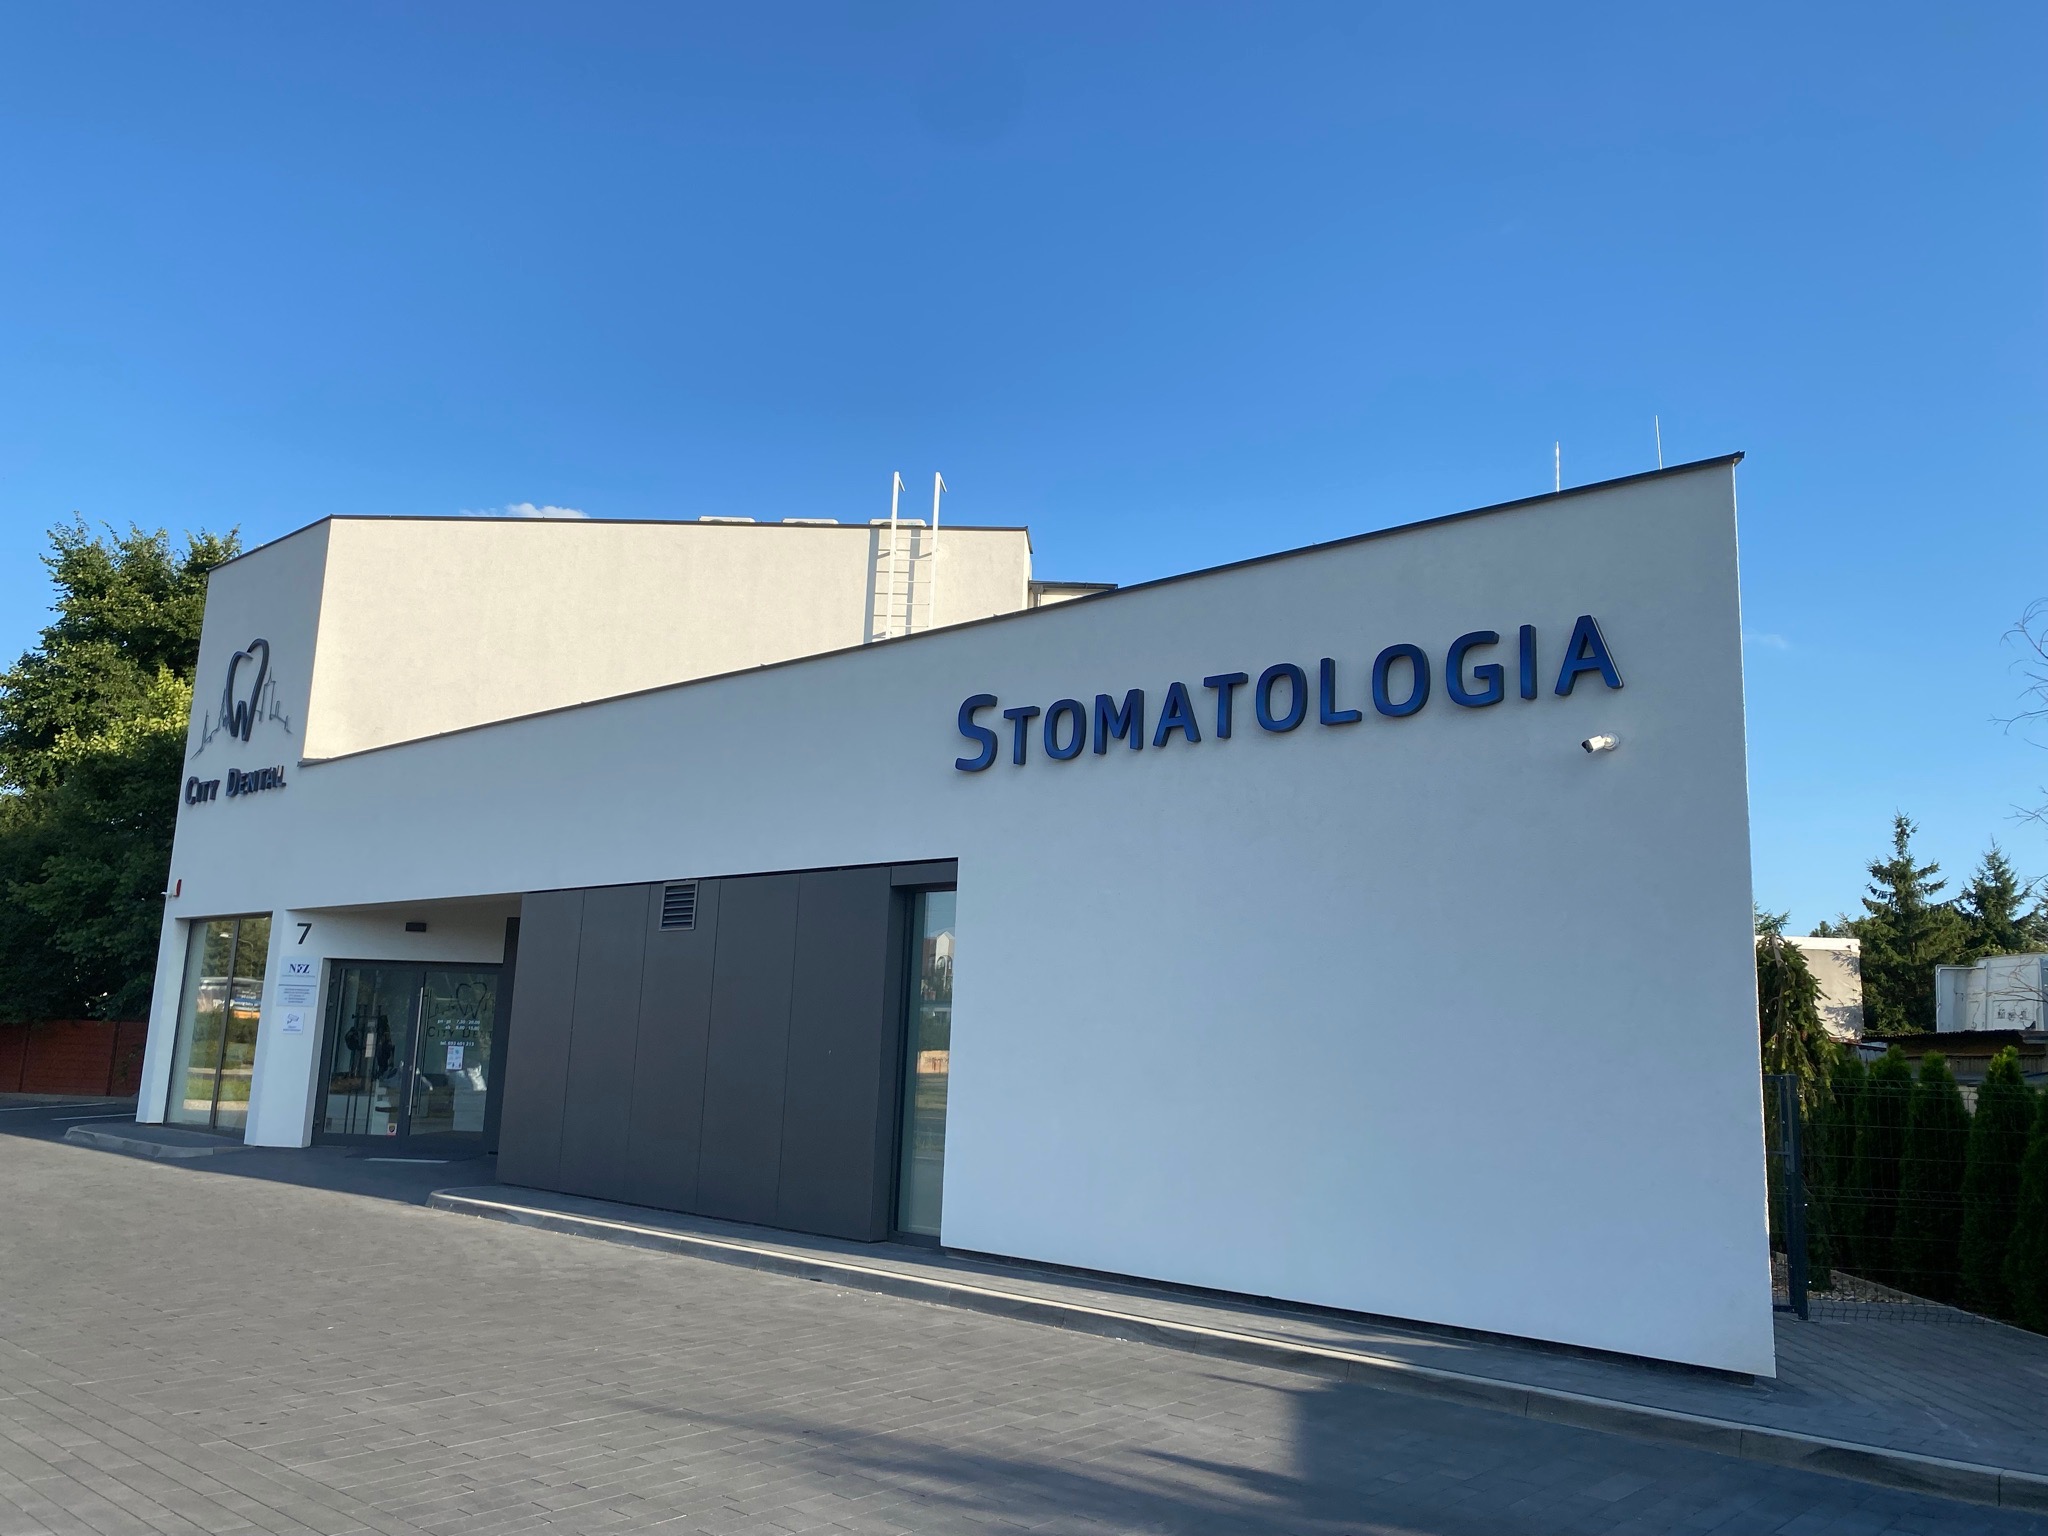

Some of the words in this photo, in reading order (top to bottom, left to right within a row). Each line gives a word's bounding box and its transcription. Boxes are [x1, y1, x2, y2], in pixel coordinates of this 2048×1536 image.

[955, 614, 1624, 773] STOMATOLOGIA
[185, 776, 220, 805] CITY
[226, 765, 287, 797] DENTAL
[297, 922, 312, 945] 7
[289, 963, 310, 974] NFZ
